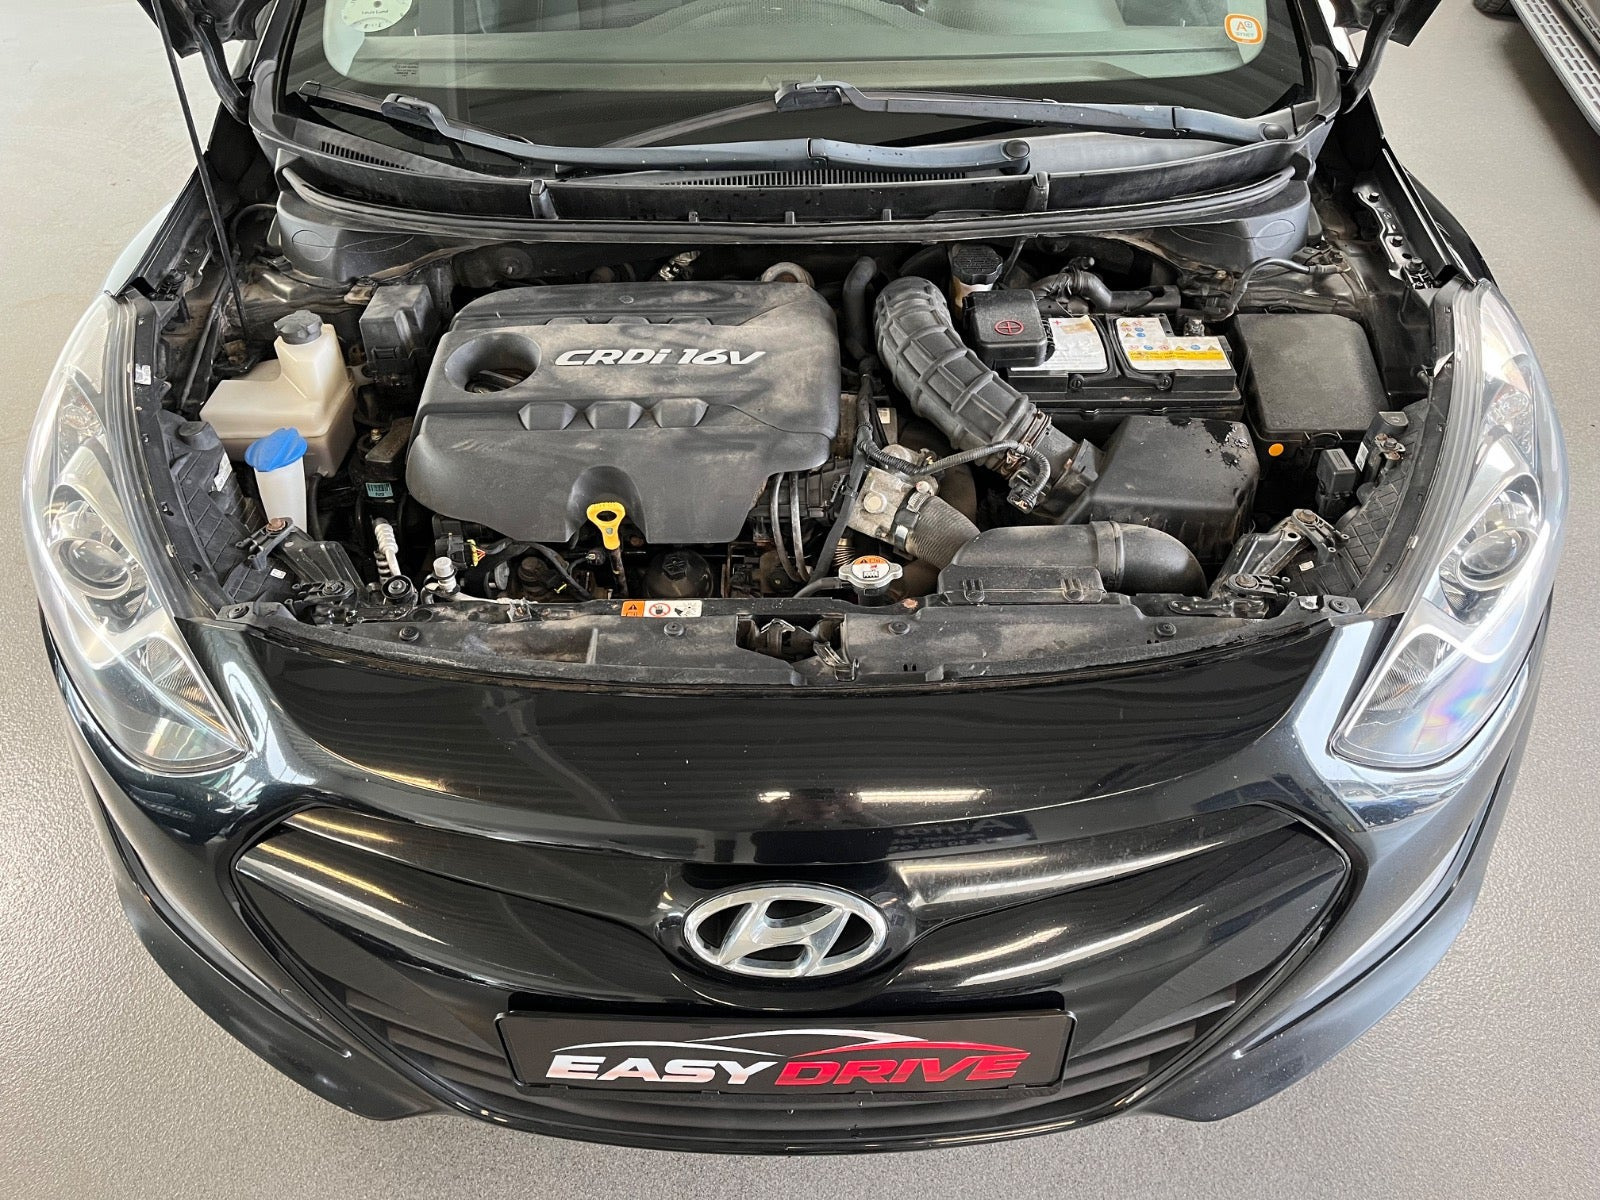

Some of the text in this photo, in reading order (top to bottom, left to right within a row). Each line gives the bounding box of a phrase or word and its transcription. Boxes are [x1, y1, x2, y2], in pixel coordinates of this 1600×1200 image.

[555, 348, 767, 366] CRDi 16V
[545, 1051, 1031, 1086] EASY DRIVE
